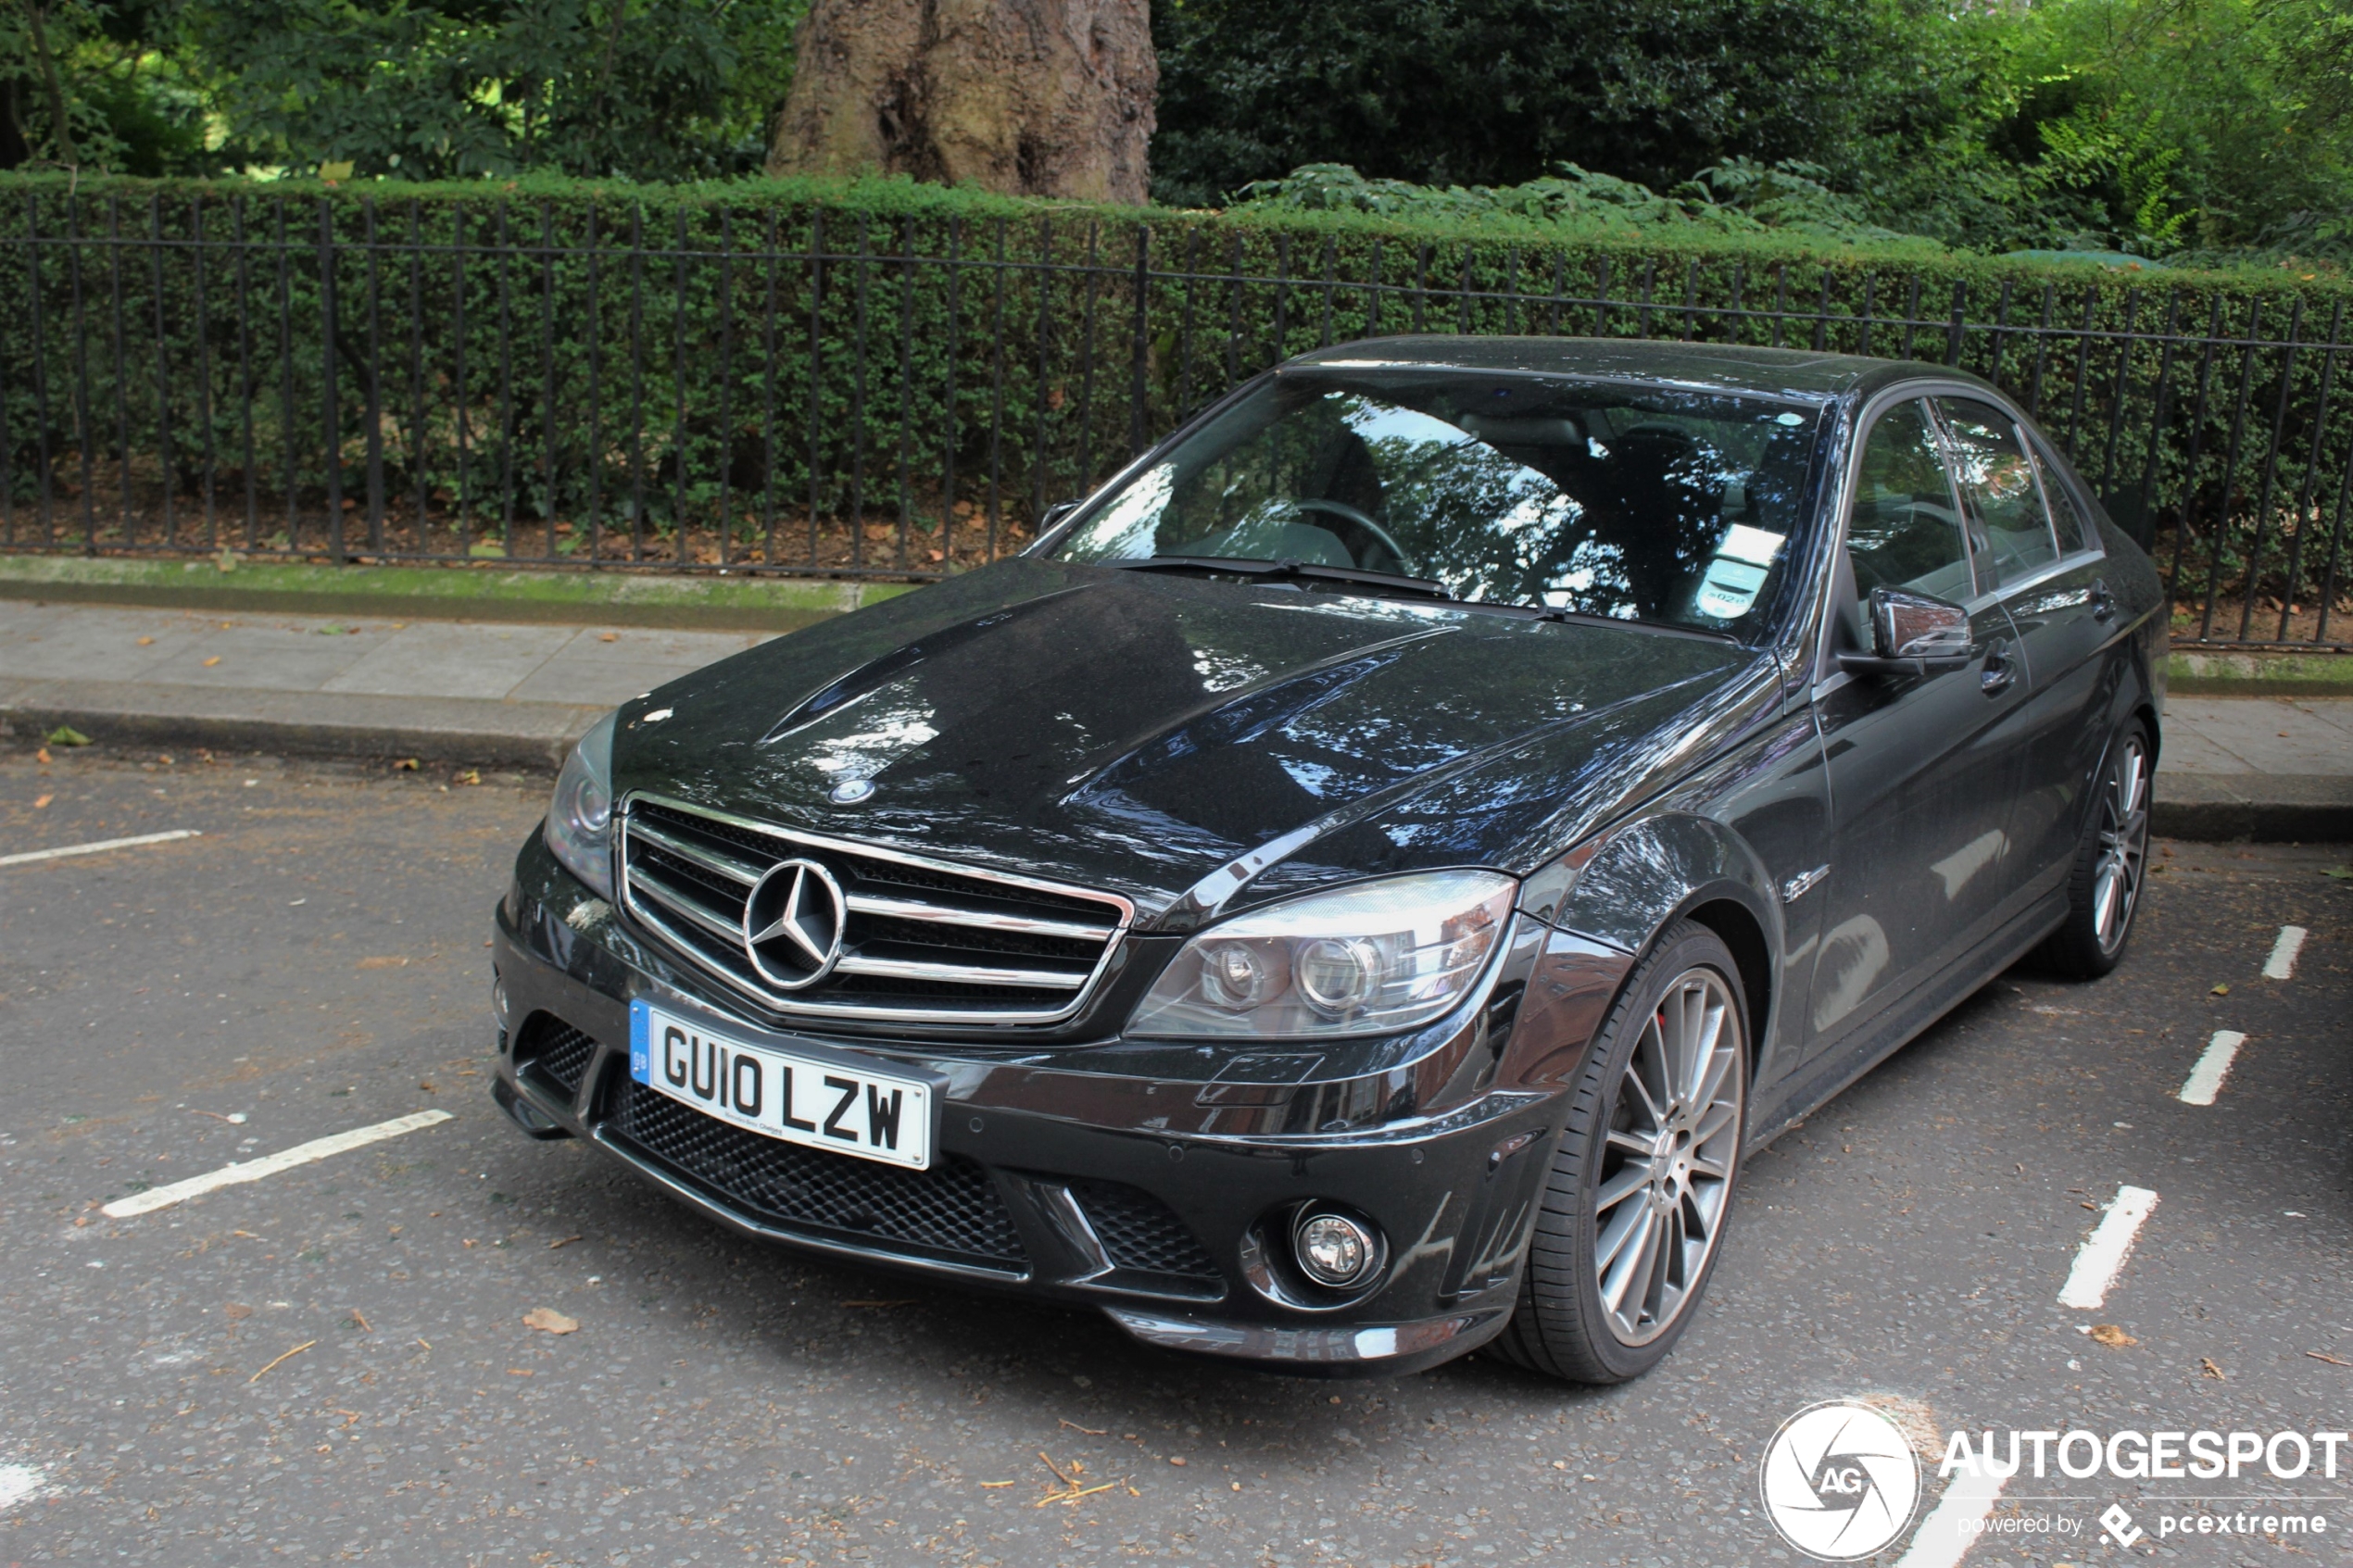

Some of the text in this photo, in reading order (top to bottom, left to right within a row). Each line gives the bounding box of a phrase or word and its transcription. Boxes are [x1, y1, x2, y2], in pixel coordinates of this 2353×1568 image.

[634, 1051, 647, 1070] GB
[665, 1025, 902, 1150] GU10 LZW
